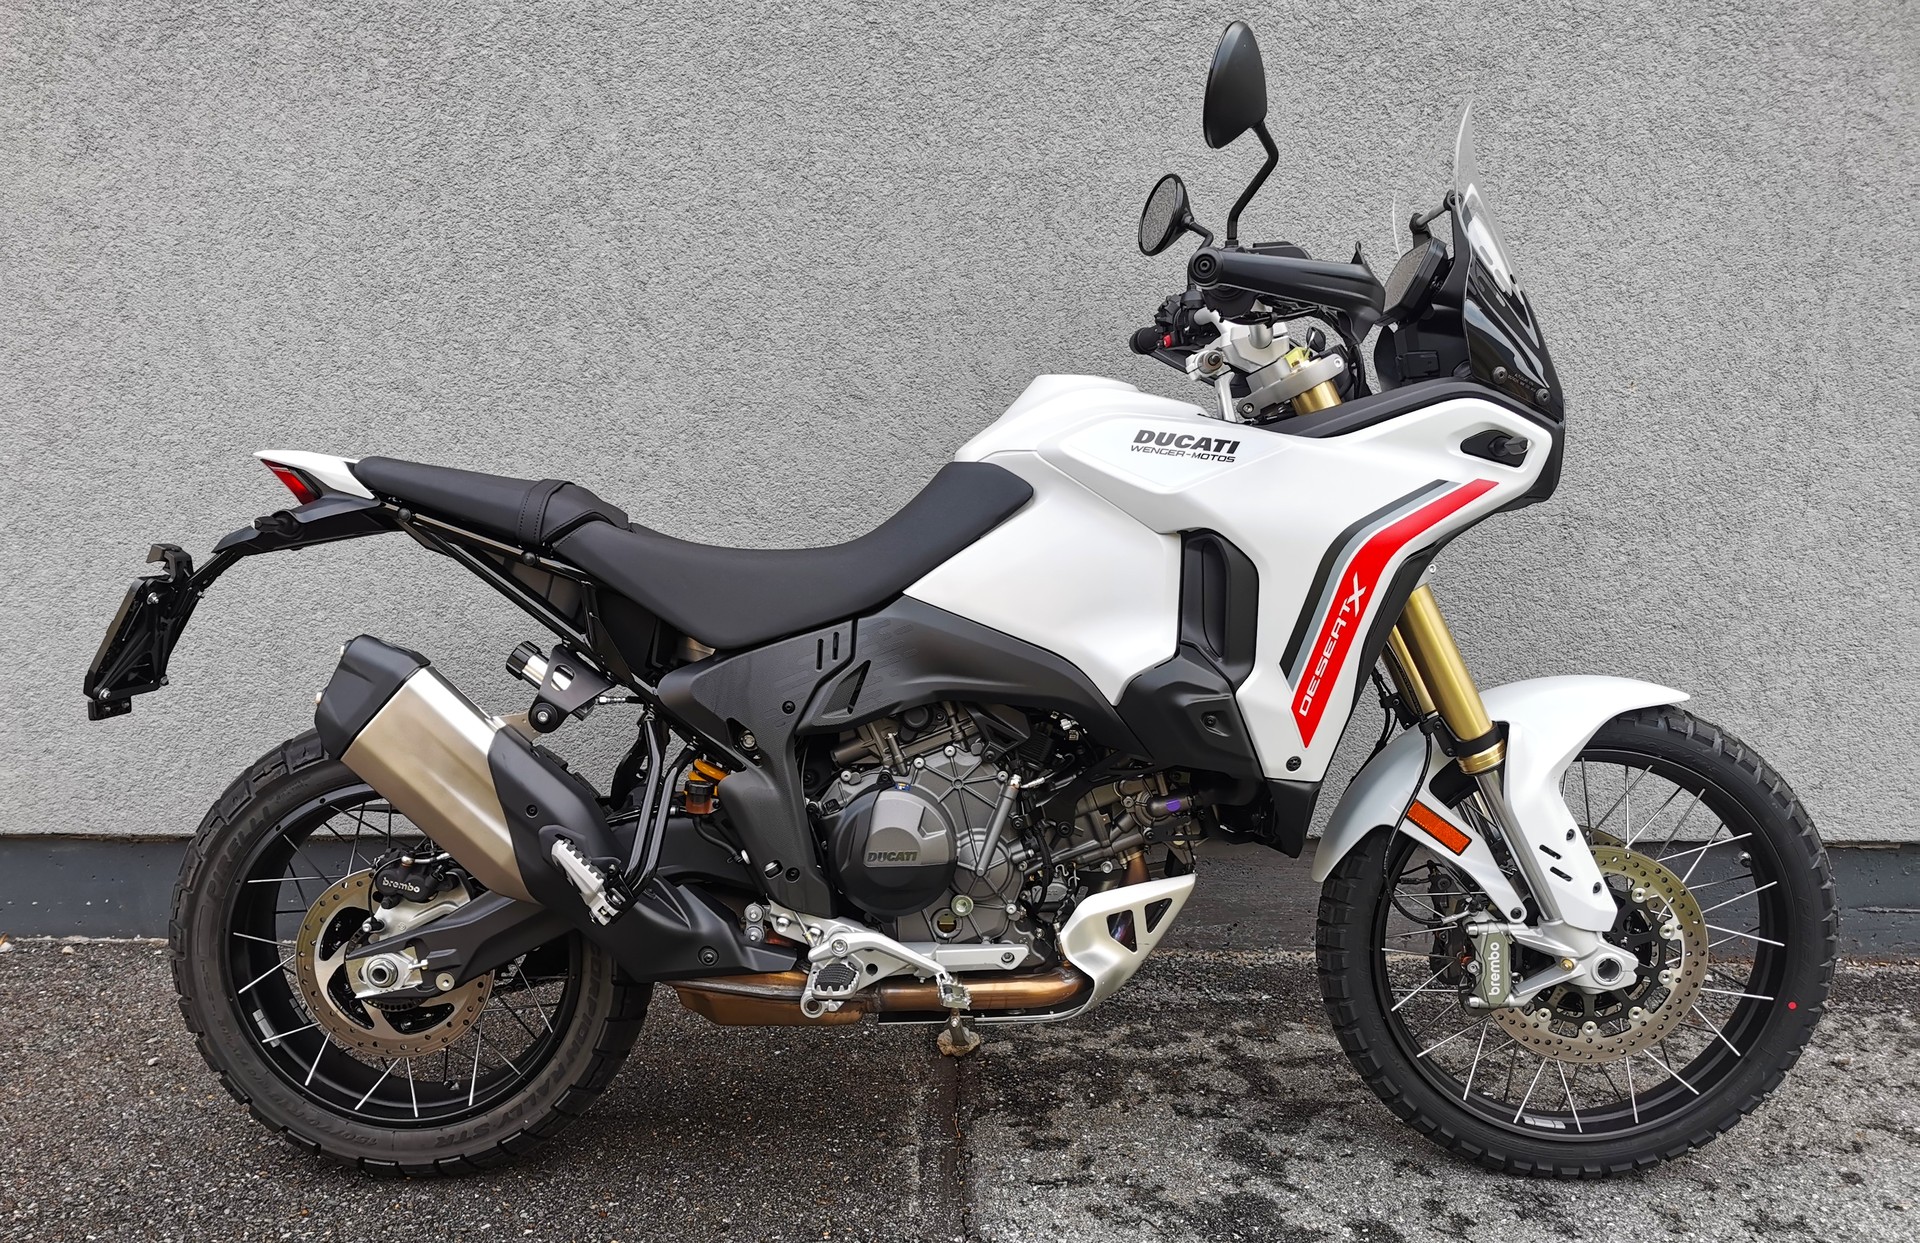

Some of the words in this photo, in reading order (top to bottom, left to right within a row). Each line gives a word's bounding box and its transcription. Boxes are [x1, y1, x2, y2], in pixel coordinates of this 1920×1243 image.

[1130, 444, 1236, 463] WENGER-MOTOS
[1133, 429, 1240, 454] DUCATI
[205, 804, 272, 901] PIRELLI
[867, 851, 918, 862] DUCATI
[382, 877, 420, 893] brembo
[1488, 942, 1500, 996] brembo
[564, 940, 602, 1067] CORPION
